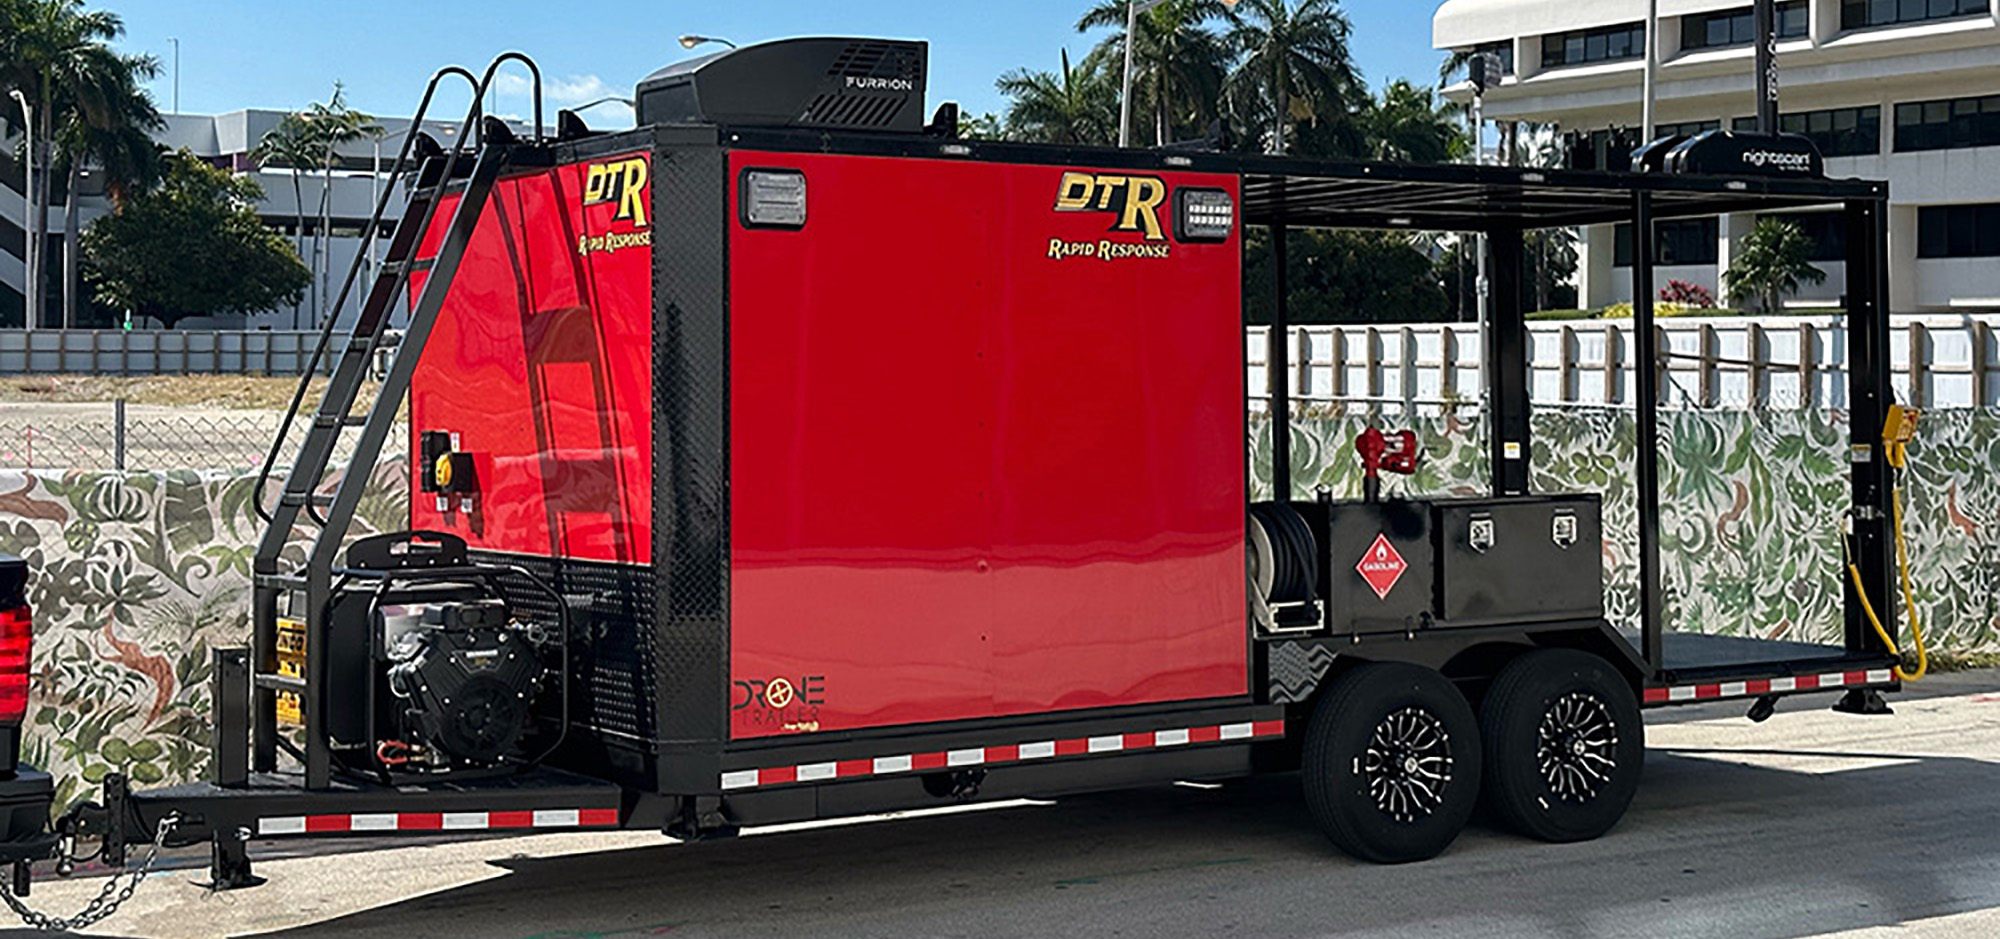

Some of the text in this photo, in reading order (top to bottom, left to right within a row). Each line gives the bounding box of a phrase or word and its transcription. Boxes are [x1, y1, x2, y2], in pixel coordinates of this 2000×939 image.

[845, 76, 913, 91] FURRION
[1743, 148, 1811, 167] nightscan
[584, 157, 648, 227] DTR
[1054, 171, 1167, 240] DTR
[1048, 238, 1170, 261] RAPID RESPONSE
